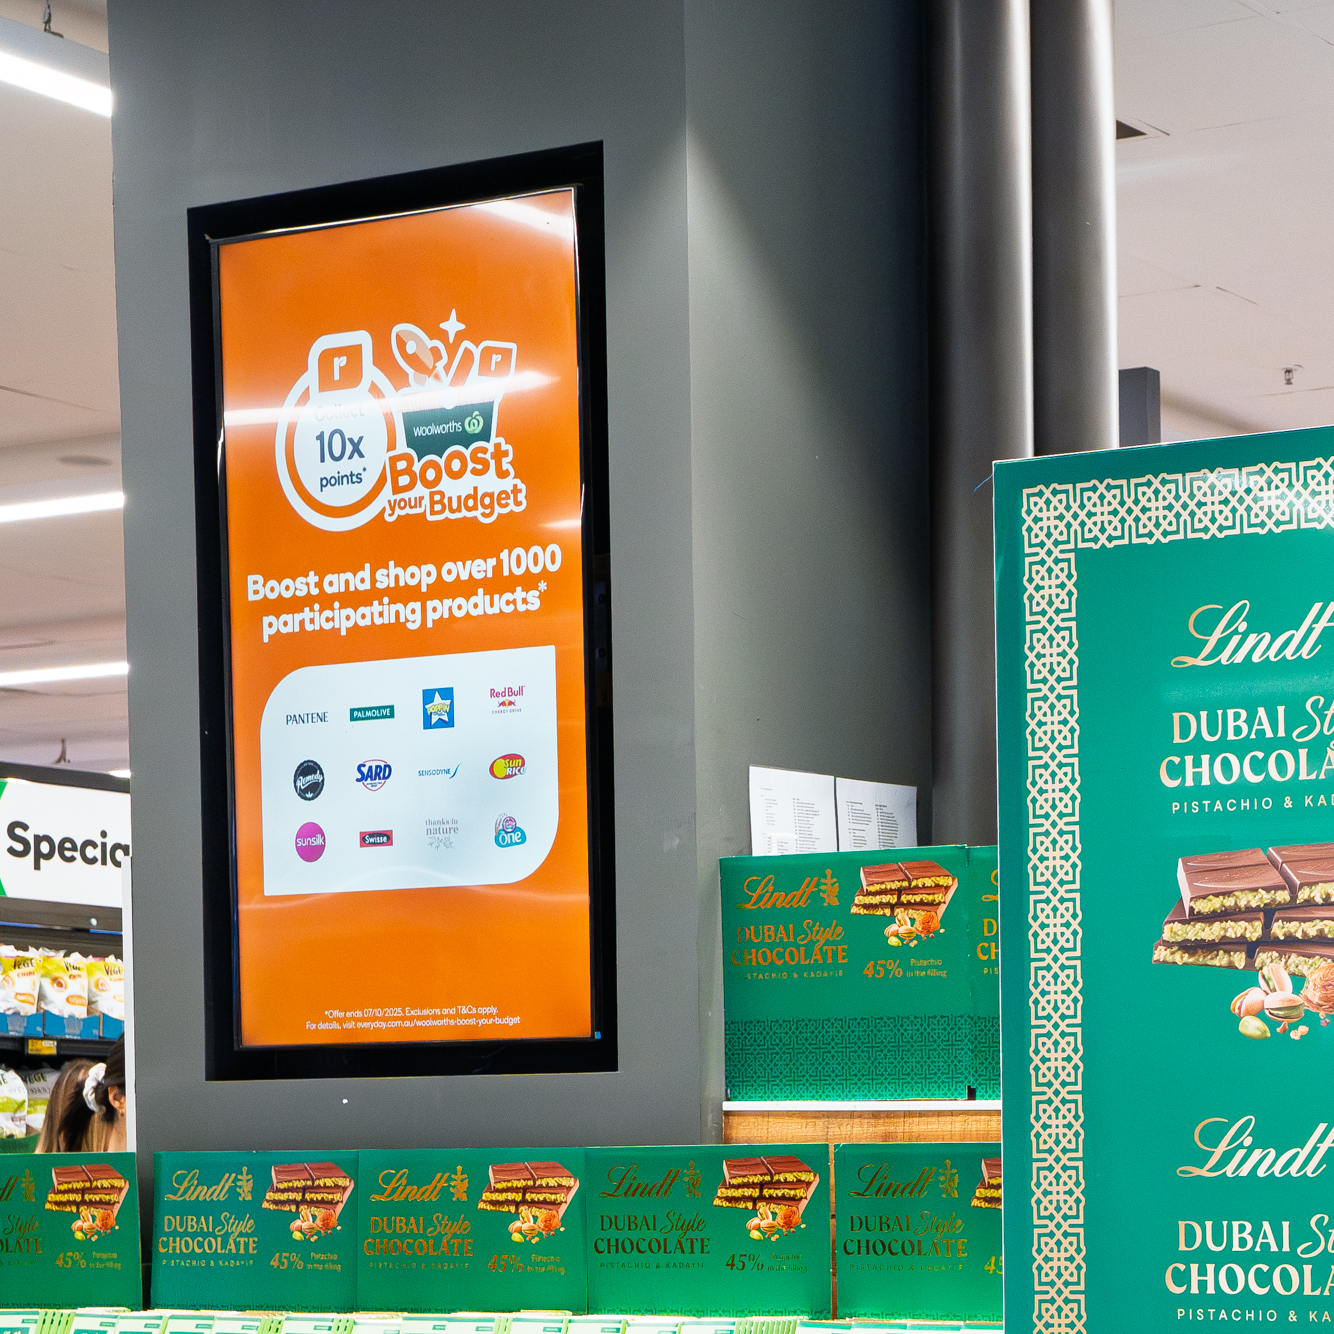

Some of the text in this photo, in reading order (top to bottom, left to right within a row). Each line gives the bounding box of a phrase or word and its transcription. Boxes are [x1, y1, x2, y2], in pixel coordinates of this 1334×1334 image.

[315, 429, 366, 463] 10x
[388, 442, 513, 496] Boost
[387, 483, 523, 521] your Budget
[247, 544, 562, 601] Boost and shop over 1000
[262, 600, 421, 643] participating
[490, 686, 524, 699] Red Bull
[286, 712, 328, 725] PANTENE
[354, 708, 390, 719] PALMOLIVE
[1173, 706, 1285, 744] DUBAI
[296, 770, 324, 793] Remedy
[356, 763, 392, 783] SARD
[418, 768, 451, 776] SENSODYNE
[1172, 798, 1272, 814] PISTACHIO
[1284, 797, 1292, 808] &
[425, 818, 449, 826] thanks
[426, 824, 458, 835] nature
[296, 836, 324, 846] sunsilk
[365, 835, 388, 844] Swisse
[736, 875, 819, 910] Lindt
[738, 920, 844, 944] DUBAI Style
[731, 945, 848, 966] CHOCOLATE
[863, 960, 903, 979] 45%
[346, 1009, 362, 1017] ends
[405, 1007, 440, 1016] Exclusions
[442, 1006, 455, 1015] and
[457, 1005, 476, 1014] T&Cs
[478, 1005, 498, 1015] apply.
[306, 1021, 316, 1029] For
[318, 1020, 341, 1030] details,
[343, 1020, 355, 1029] visit
[164, 1171, 235, 1201] Lindt
[164, 1213, 255, 1236] DUBAI Style
[158, 1238, 257, 1254] CHOCOLATE
[1178, 1221, 1290, 1252] DUBAI
[270, 1252, 304, 1271] 45%
[1177, 1309, 1277, 1321] PISTACHIO
[1288, 1310, 1297, 1321] &
